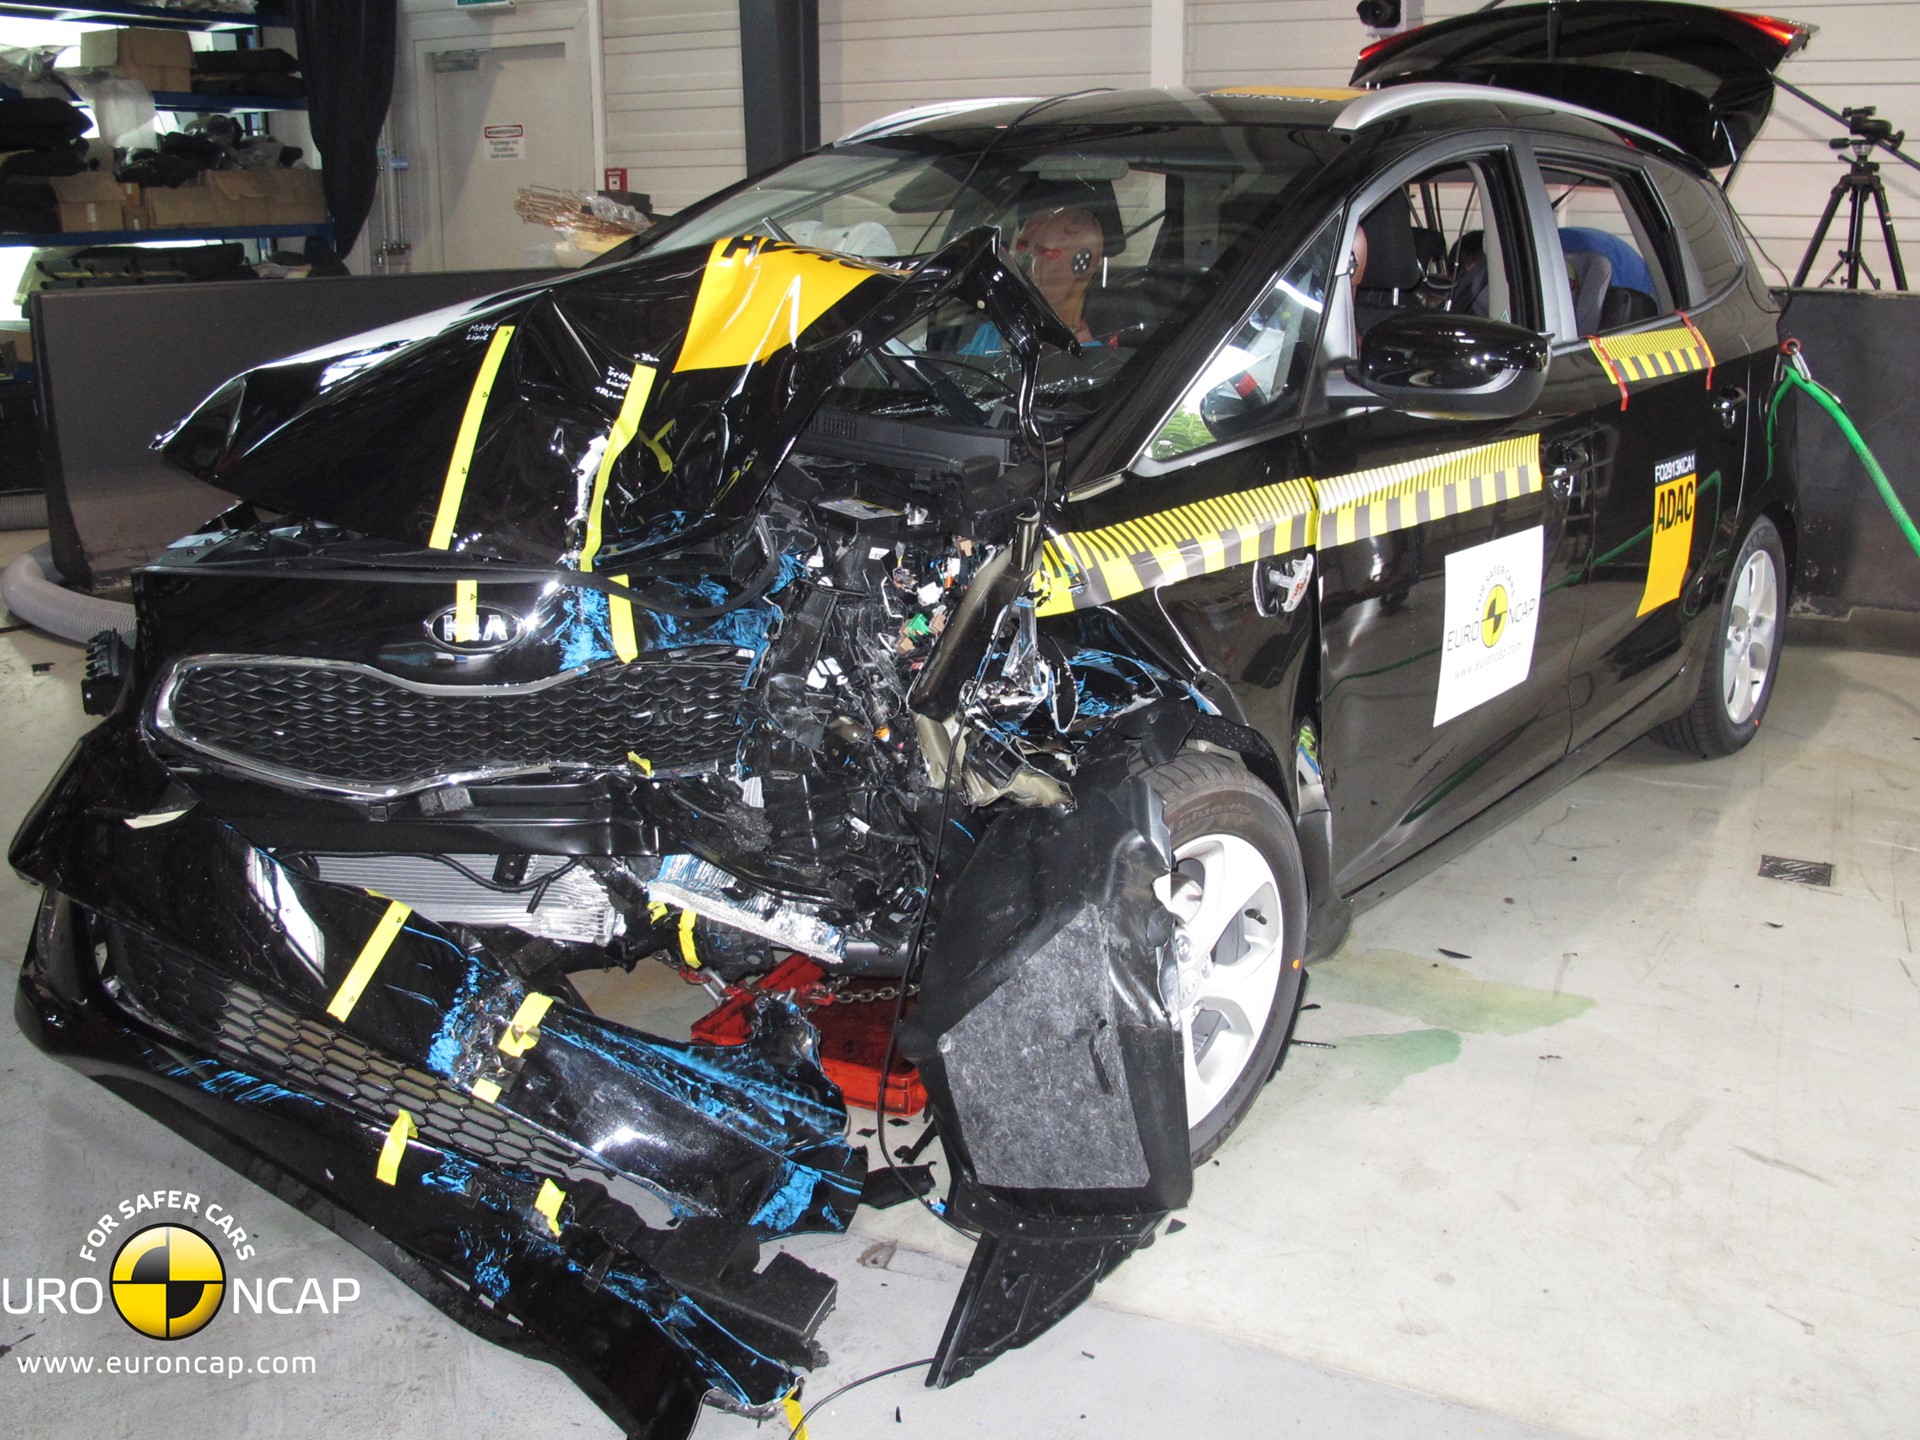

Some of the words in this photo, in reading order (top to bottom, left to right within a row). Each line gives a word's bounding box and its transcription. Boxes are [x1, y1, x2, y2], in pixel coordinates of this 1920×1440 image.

[1656, 481, 1693, 534] ADAC
[1447, 621, 1480, 652] EURO
[1507, 598, 1536, 627] NCAP
